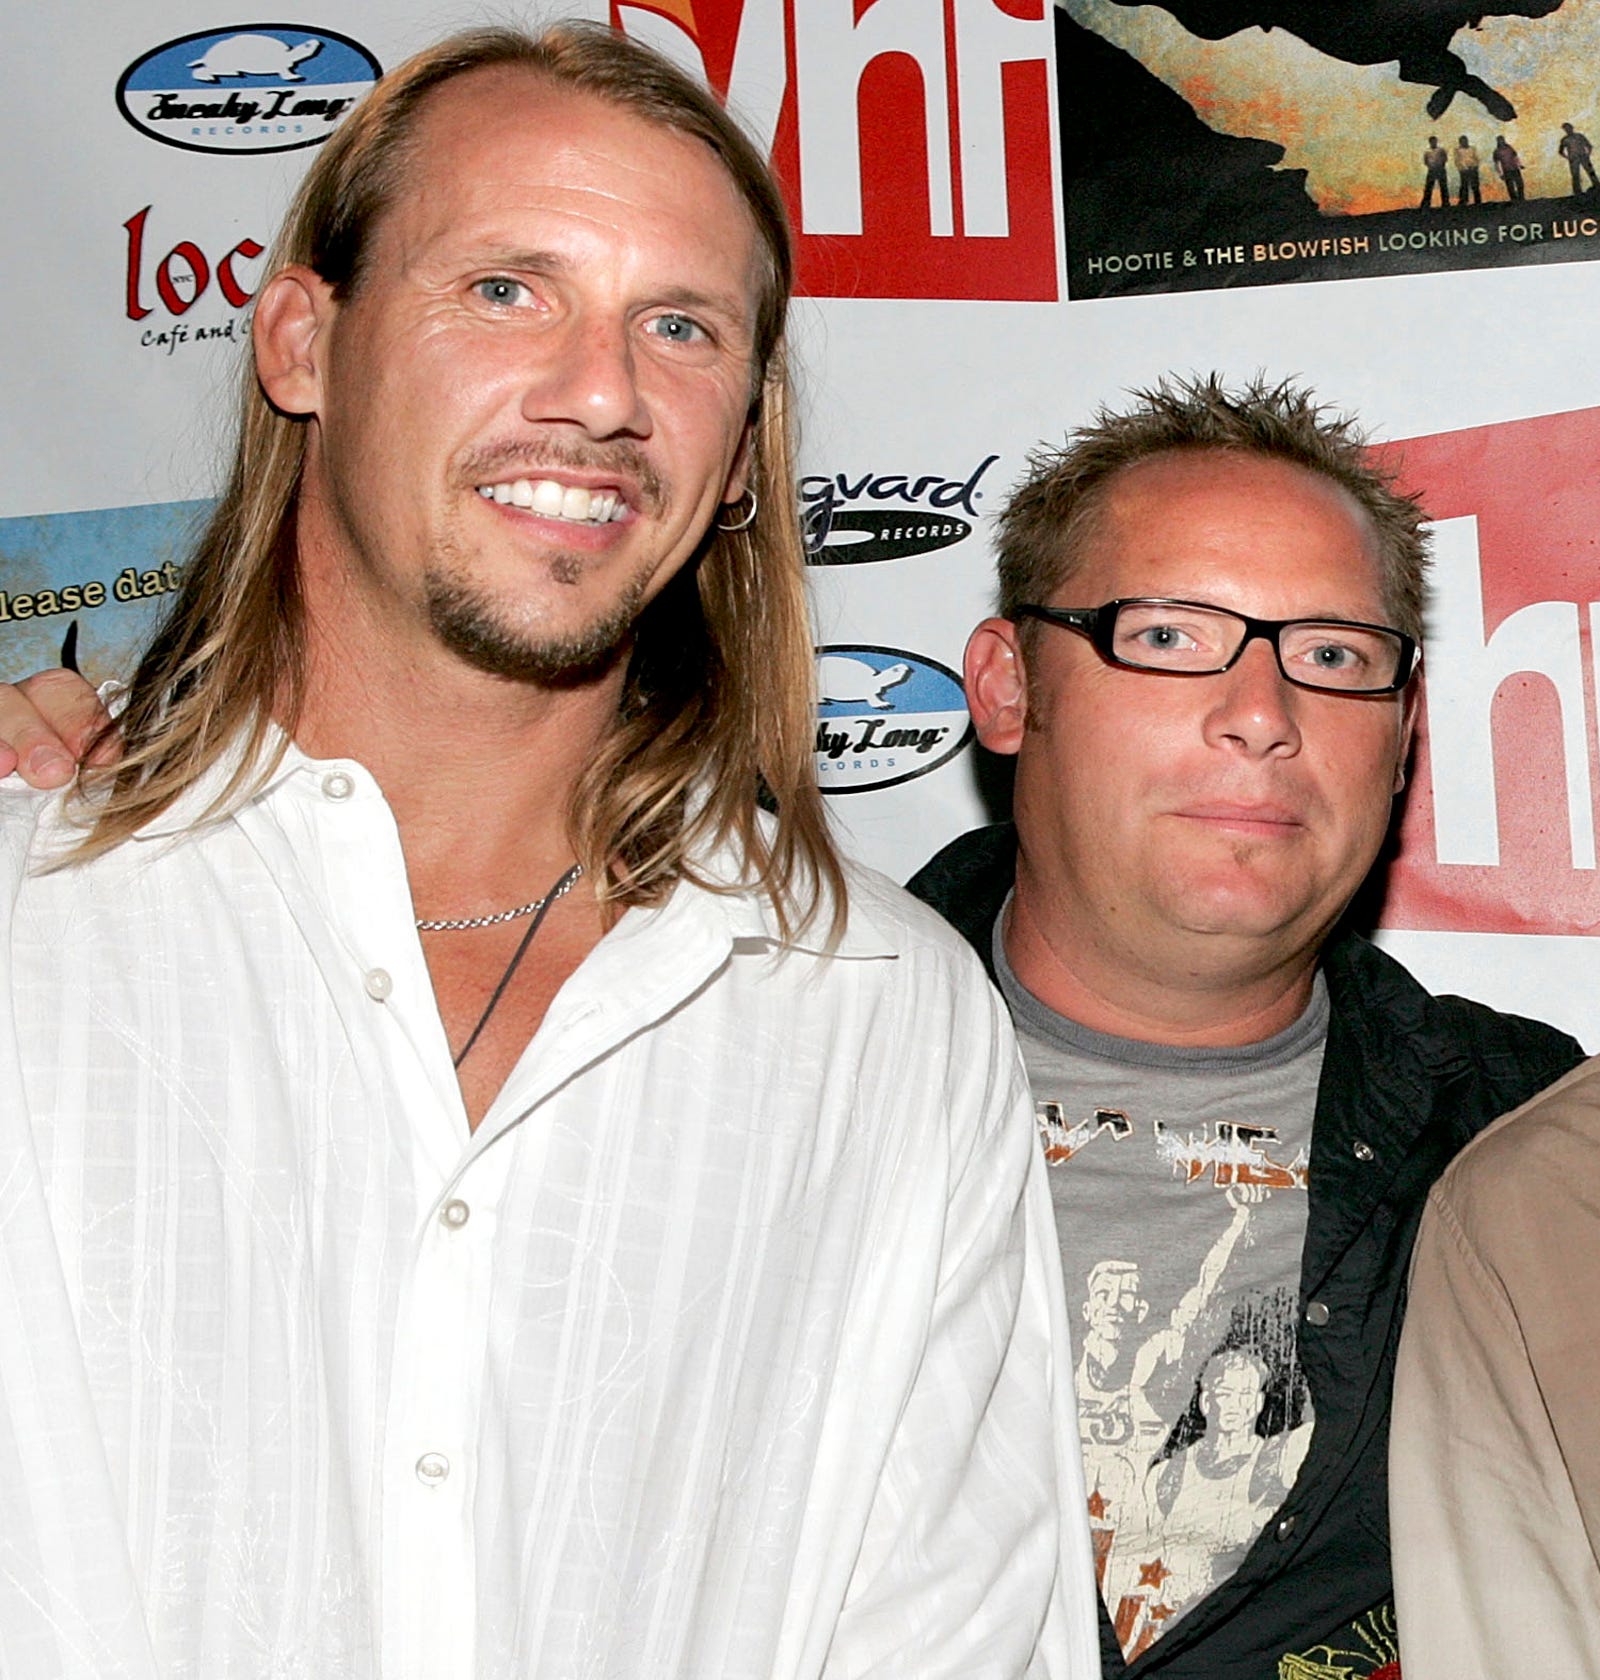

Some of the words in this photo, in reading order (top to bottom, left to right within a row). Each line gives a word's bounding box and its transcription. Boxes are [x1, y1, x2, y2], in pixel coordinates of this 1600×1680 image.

[147, 92, 262, 124] Sneaky
[191, 124, 304, 136] RECORDS
[122, 204, 265, 321] loc
[1088, 251, 1173, 275] HOOTIE
[1182, 250, 1198, 267] &
[1204, 246, 1245, 265] THE
[1253, 236, 1369, 262] BLOWFISH
[1378, 227, 1489, 251] LOOKING
[1498, 223, 1543, 243] FOR
[141, 323, 190, 356] Café
[195, 318, 236, 343] and
[880, 523, 965, 541] RECORDS
[0, 581, 106, 623] lease
[113, 560, 182, 602] dat
[852, 719, 949, 754] Long
[819, 757, 897, 772] CORDS
